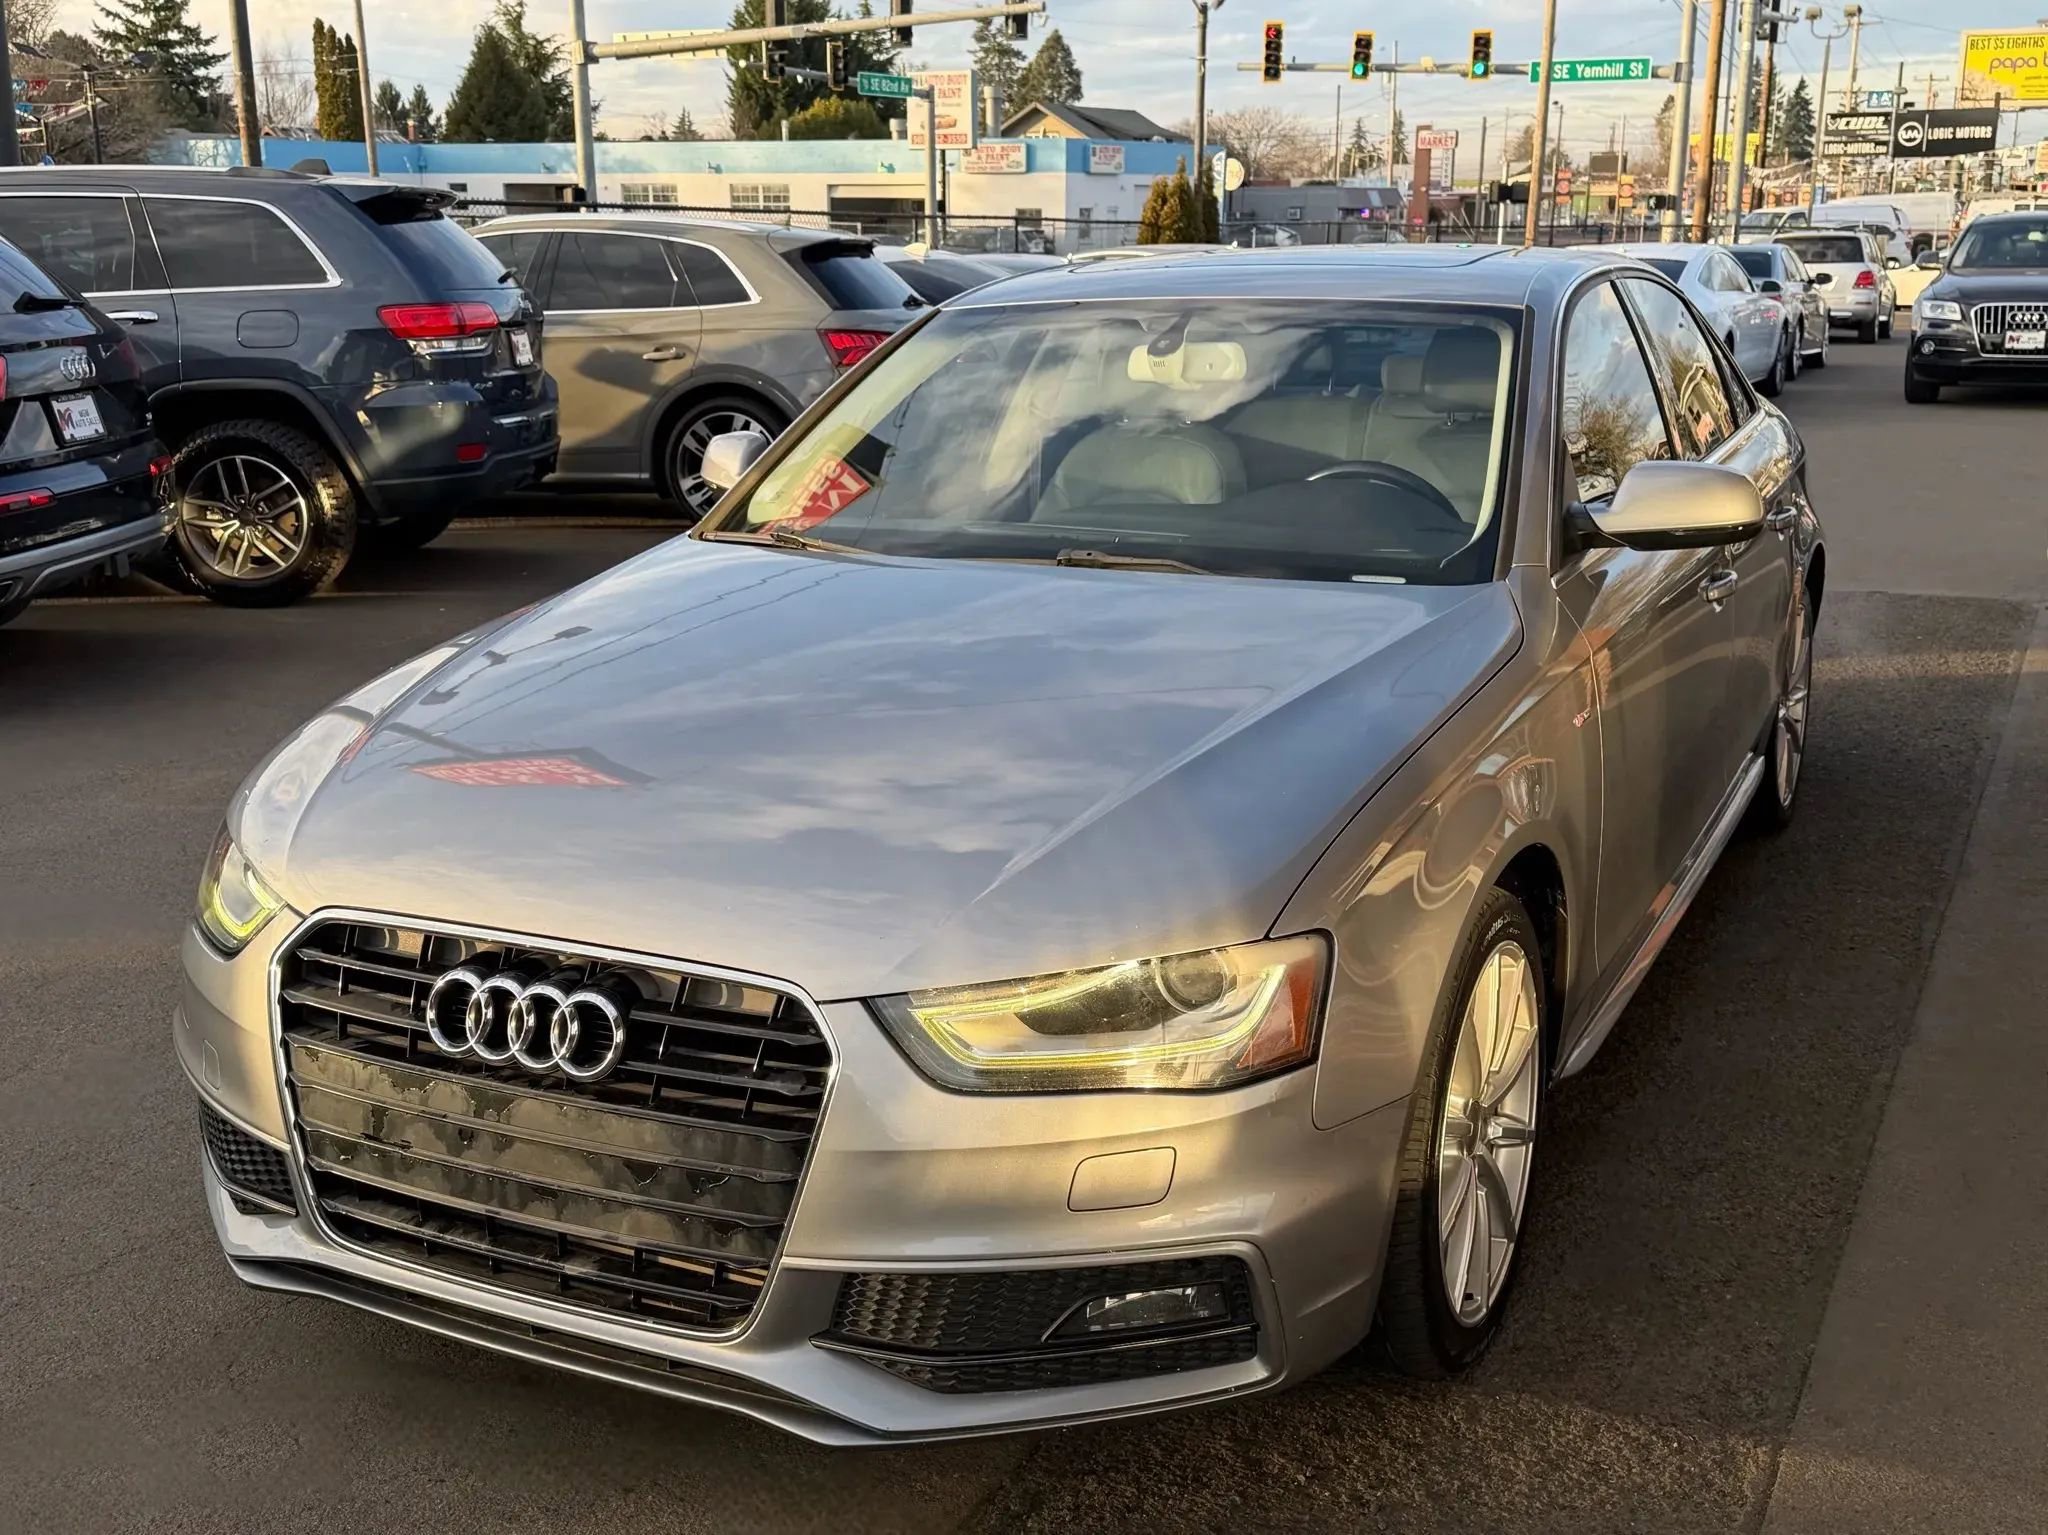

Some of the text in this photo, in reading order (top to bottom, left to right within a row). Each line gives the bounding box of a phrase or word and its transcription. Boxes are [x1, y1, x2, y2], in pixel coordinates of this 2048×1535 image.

[1970, 38, 1992, 50] BEST
[2006, 36, 2046, 49] EIGHTHS
[1553, 62, 1643, 79] SE Yamhill St
[1989, 56, 2038, 74] papa
[870, 78, 880, 91] SE
[1928, 128, 1954, 140] LOGIC
[1956, 126, 1992, 139] MOTORS
[1420, 137, 1454, 147] MARKET
